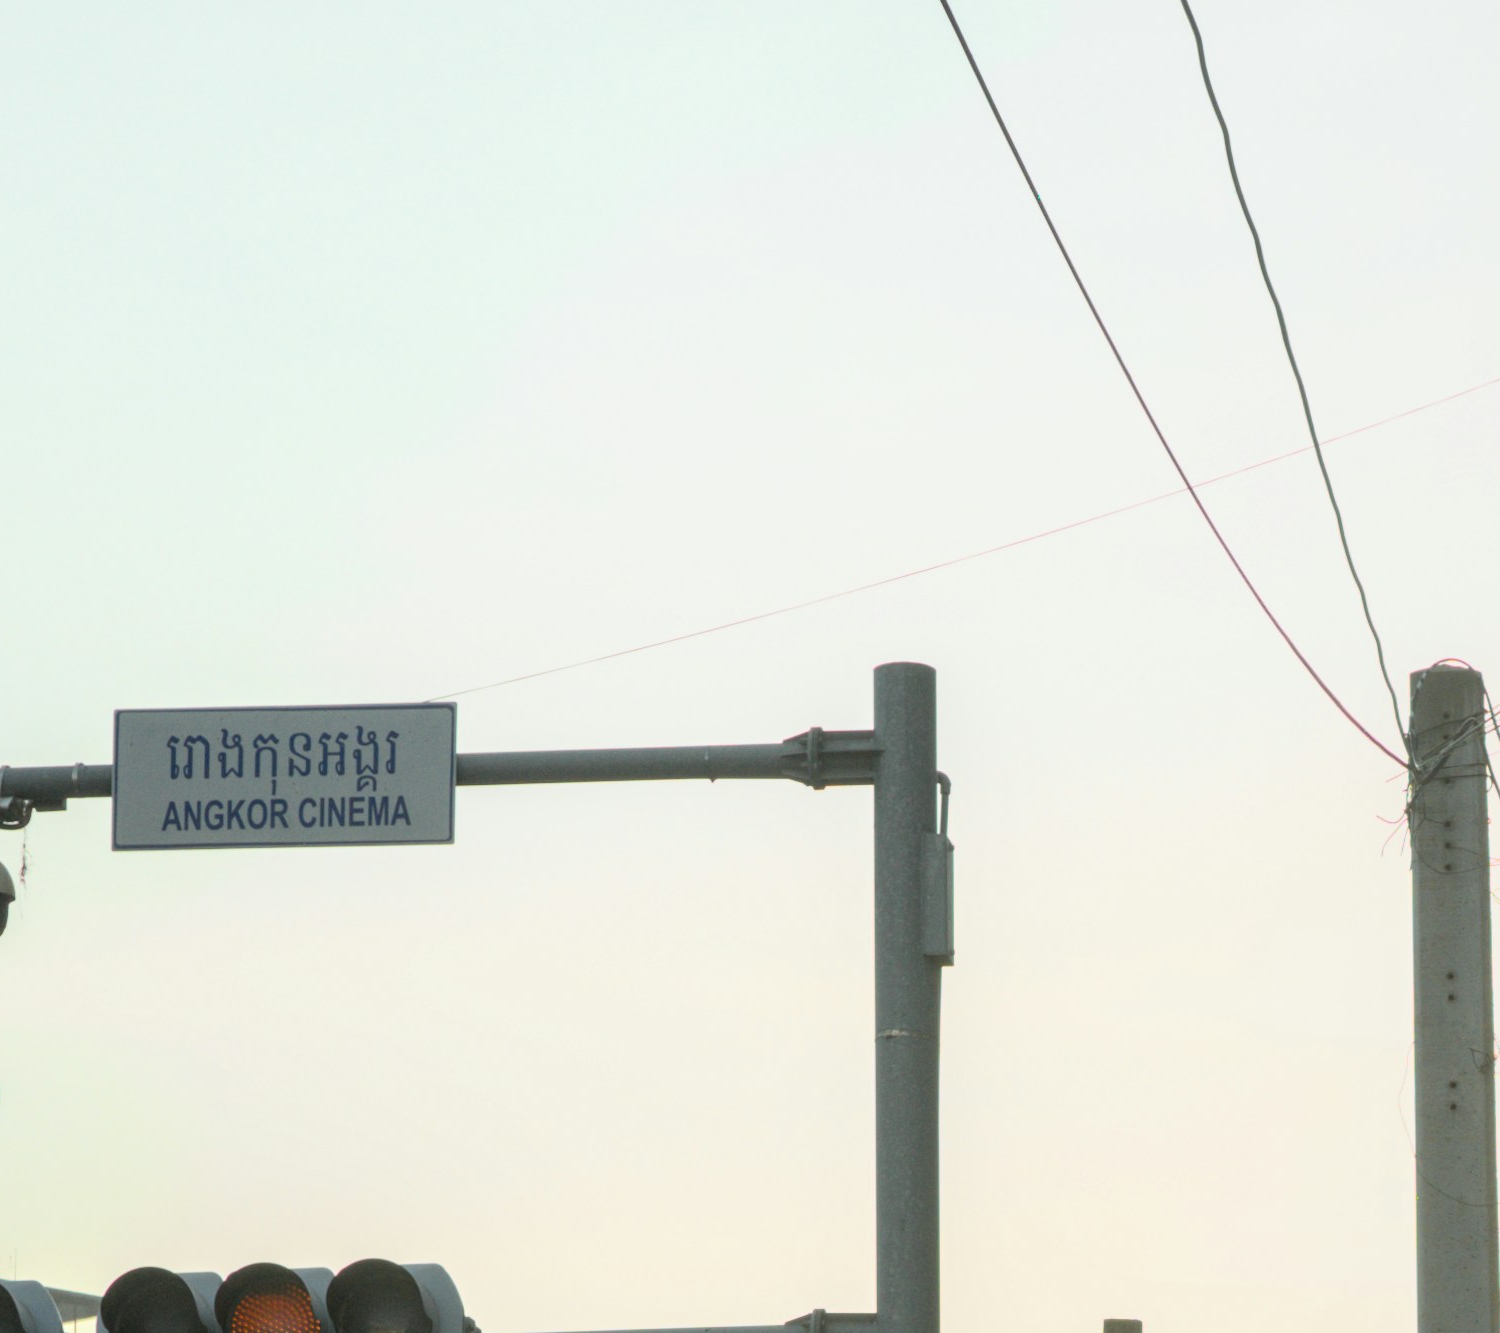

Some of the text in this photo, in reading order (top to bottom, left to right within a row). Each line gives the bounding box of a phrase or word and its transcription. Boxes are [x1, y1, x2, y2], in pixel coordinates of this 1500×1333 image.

[166, 725, 400, 796] រោងកុនអង្គរ
[161, 795, 411, 832] ANGKOR CINEMA
